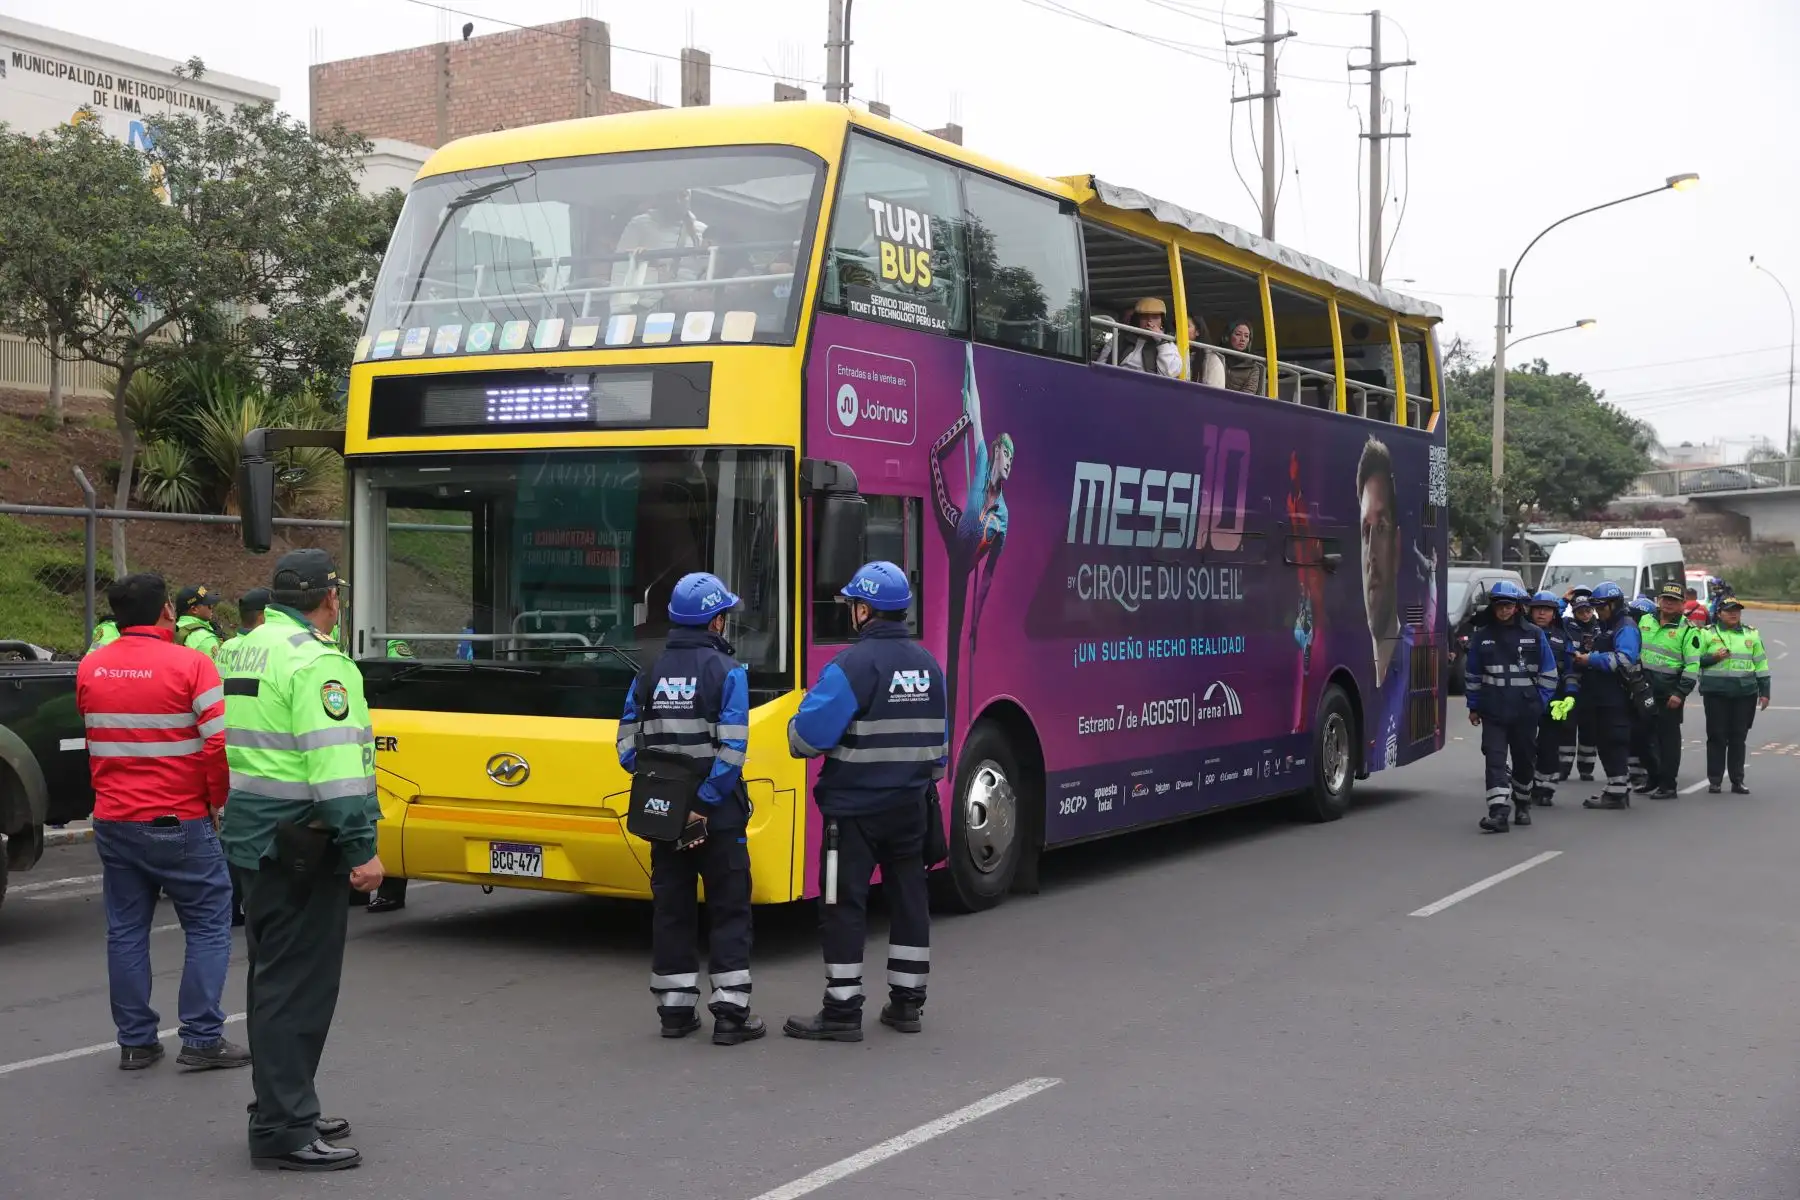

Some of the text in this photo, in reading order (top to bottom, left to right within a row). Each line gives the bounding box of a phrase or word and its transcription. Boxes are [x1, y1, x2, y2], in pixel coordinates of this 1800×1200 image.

[12, 51, 213, 113] MUNICIPALIDAD METROPOLITANA
[93, 90, 142, 115] DE LIMA
[868, 197, 932, 250] TURI
[880, 240, 932, 288] BUS
[850, 300, 871, 315] TICKET
[871, 305, 877, 316] &
[877, 306, 916, 324] TECHNOLOGY
[870, 294, 927, 316] SERVICIO TURÍSTICO
[837, 363, 867, 380] Entradas
[872, 370, 879, 382] la
[879, 374, 897, 385] venta
[861, 398, 908, 425] Joinnus
[856, 577, 880, 595] ATU
[1067, 563, 1243, 612] BY CIRQUE DU SOLEIL
[701, 589, 721, 611] ATU
[1073, 635, 1245, 669] ¡UN SUEÑO HECHO REALIDAD!
[108, 669, 152, 679] SUTRAN
[888, 669, 931, 694] ATU
[652, 676, 697, 700] ATU
[1078, 698, 1190, 735] Estreno 7 de AGOSTO
[1094, 783, 1118, 800] apuesta
[1098, 798, 1113, 812] total
[492, 850, 540, 873] BCQ-477
